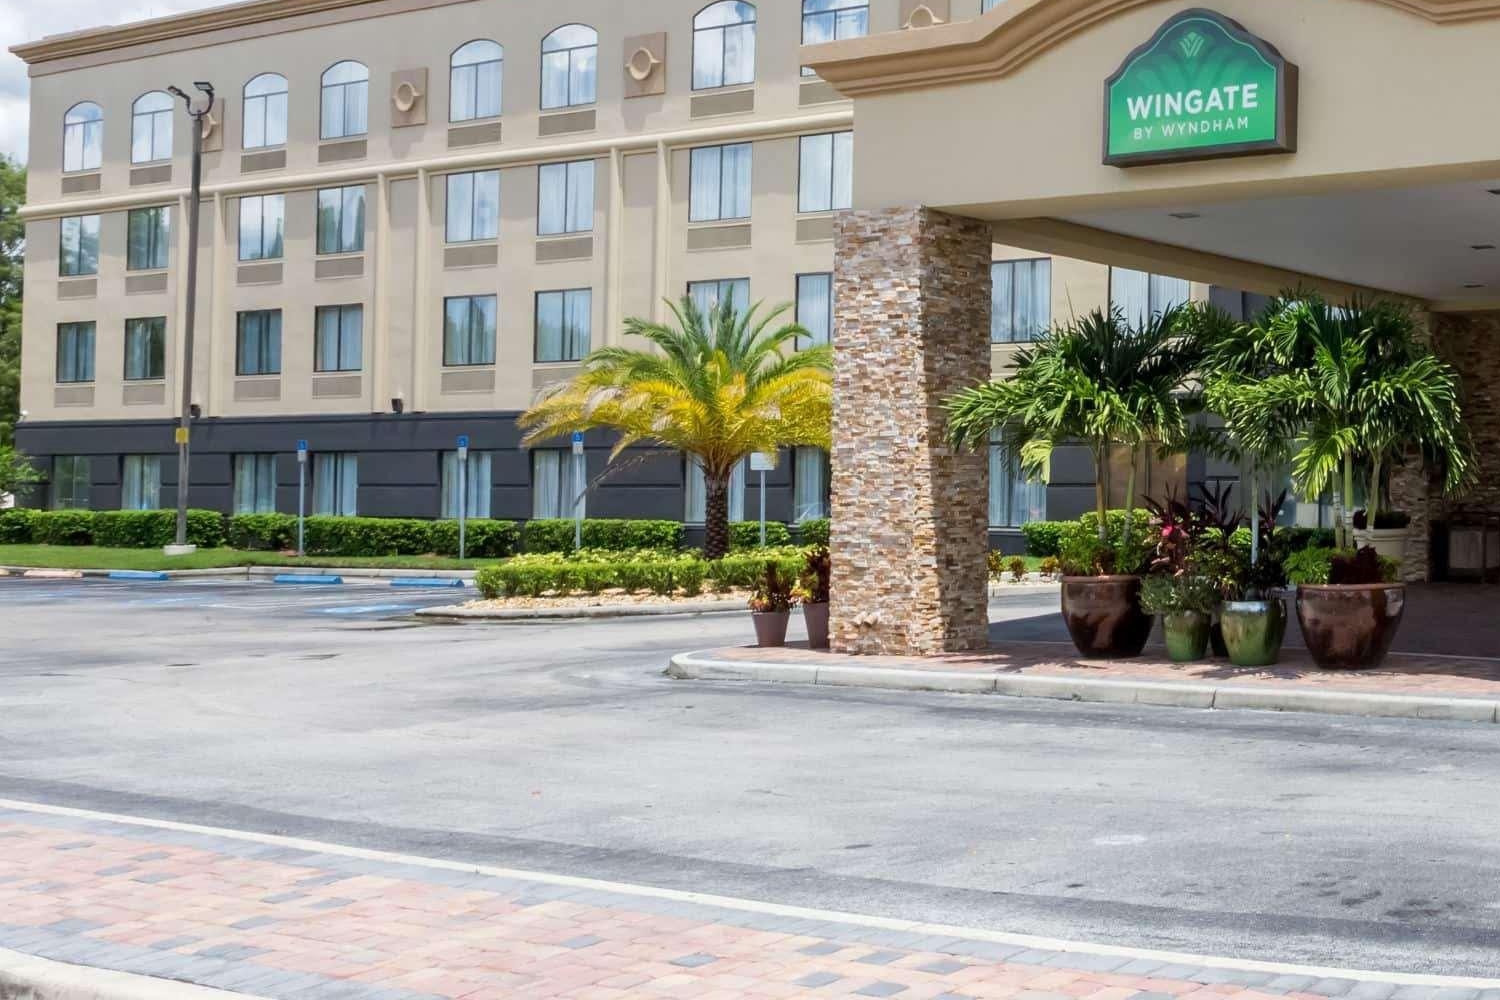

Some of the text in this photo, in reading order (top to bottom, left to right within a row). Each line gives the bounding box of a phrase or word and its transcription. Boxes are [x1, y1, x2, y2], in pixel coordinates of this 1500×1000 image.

[1127, 83, 1258, 120] WINGATE
[1134, 117, 1249, 139] BY WYNDHAM
